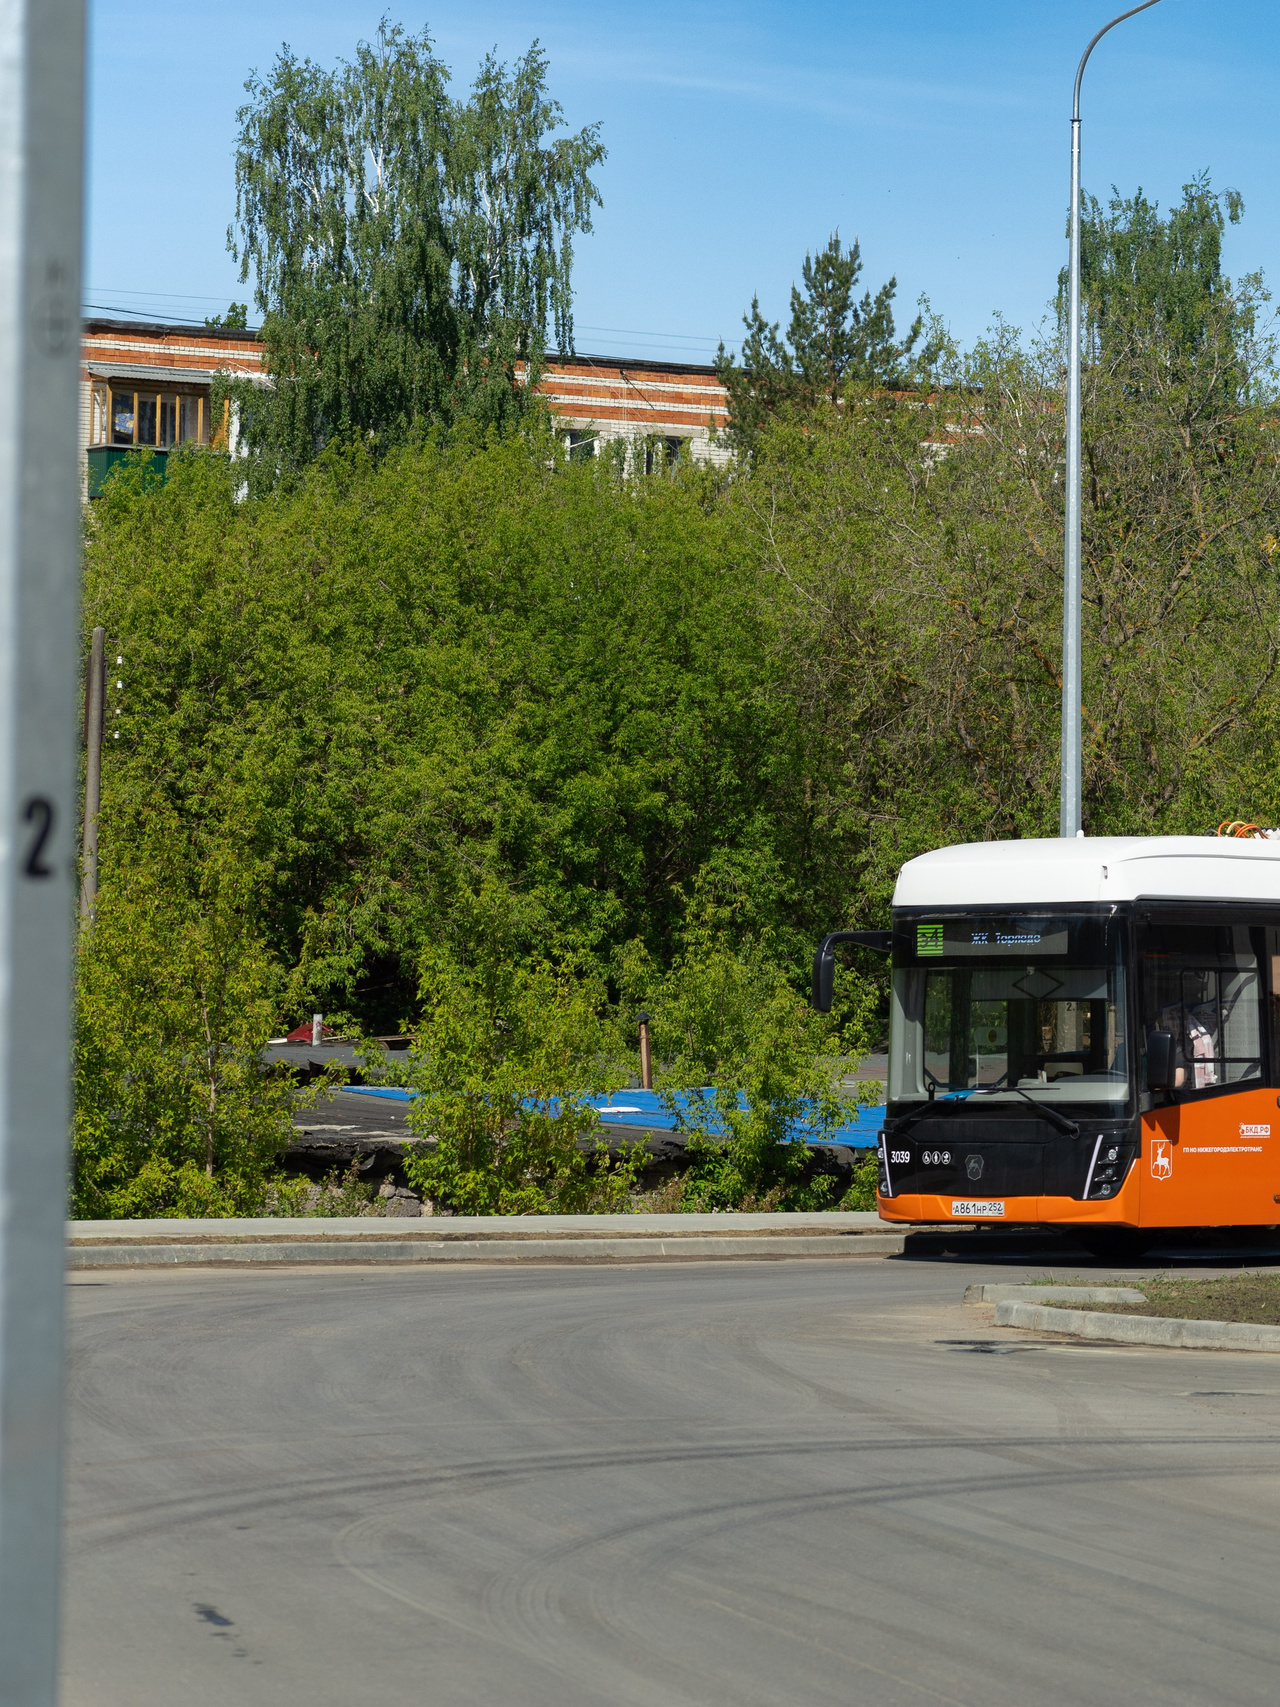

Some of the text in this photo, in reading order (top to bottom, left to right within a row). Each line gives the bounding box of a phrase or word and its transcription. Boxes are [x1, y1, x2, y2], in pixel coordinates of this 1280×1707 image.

[971, 932, 989, 944] ЖК
[890, 1151, 911, 1164] 3039
[988, 1202, 1002, 1212] 252
